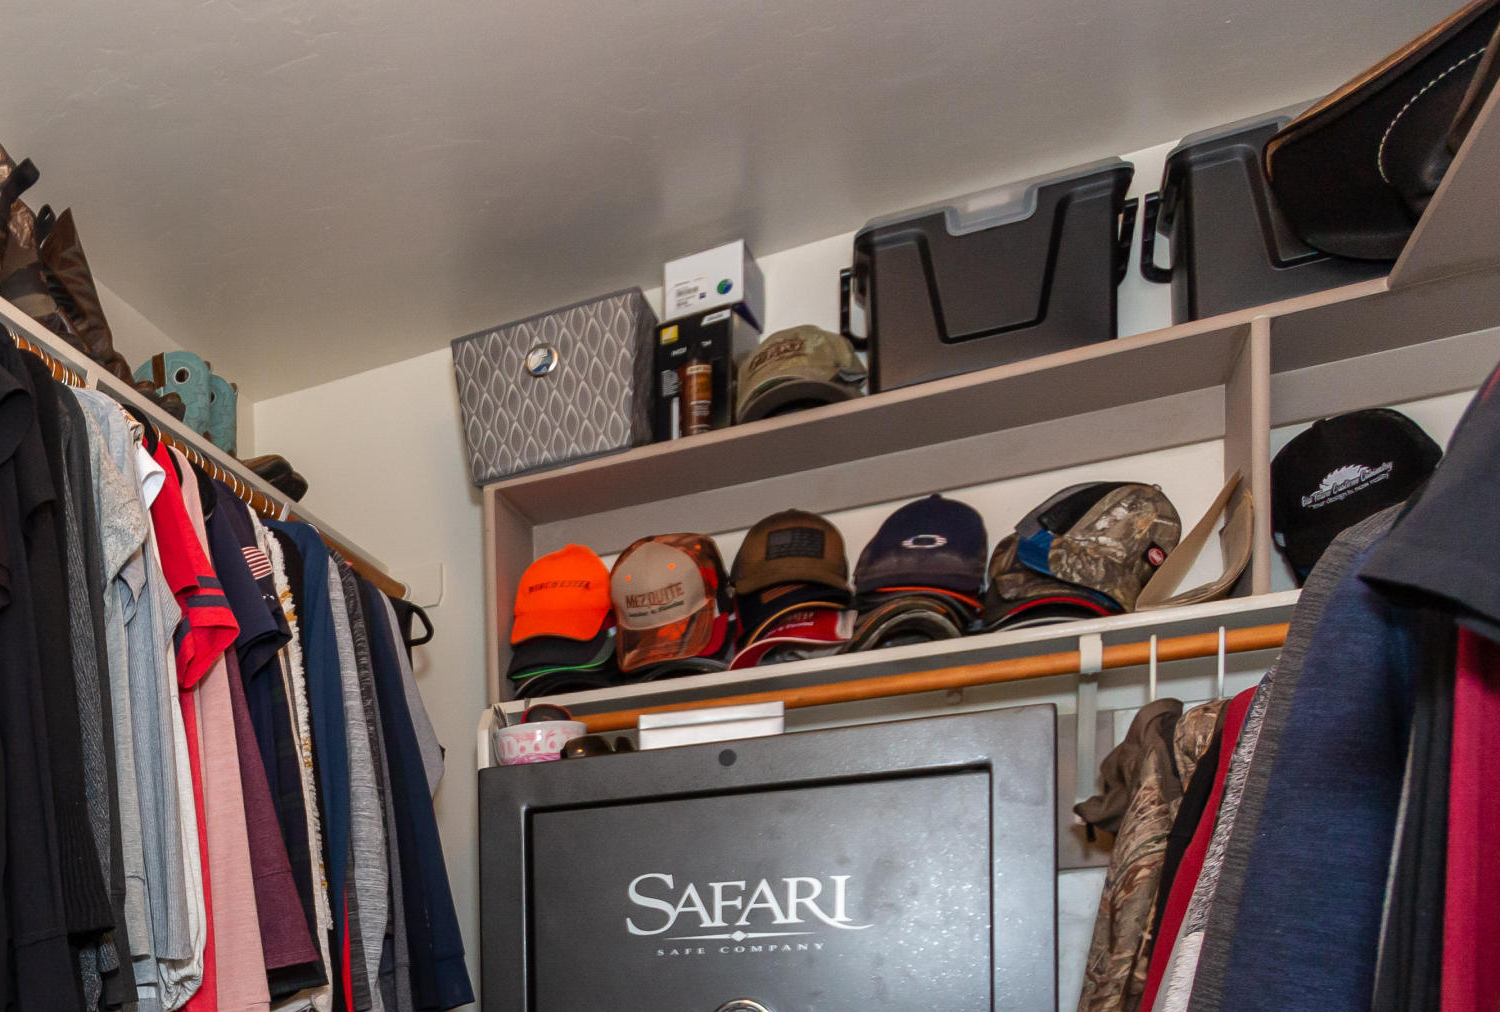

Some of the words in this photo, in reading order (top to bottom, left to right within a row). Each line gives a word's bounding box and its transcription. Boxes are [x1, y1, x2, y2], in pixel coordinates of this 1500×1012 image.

[626, 873, 874, 936] SAFARI
[656, 947, 706, 957] SAFE
[720, 942, 825, 954] COMPANY
